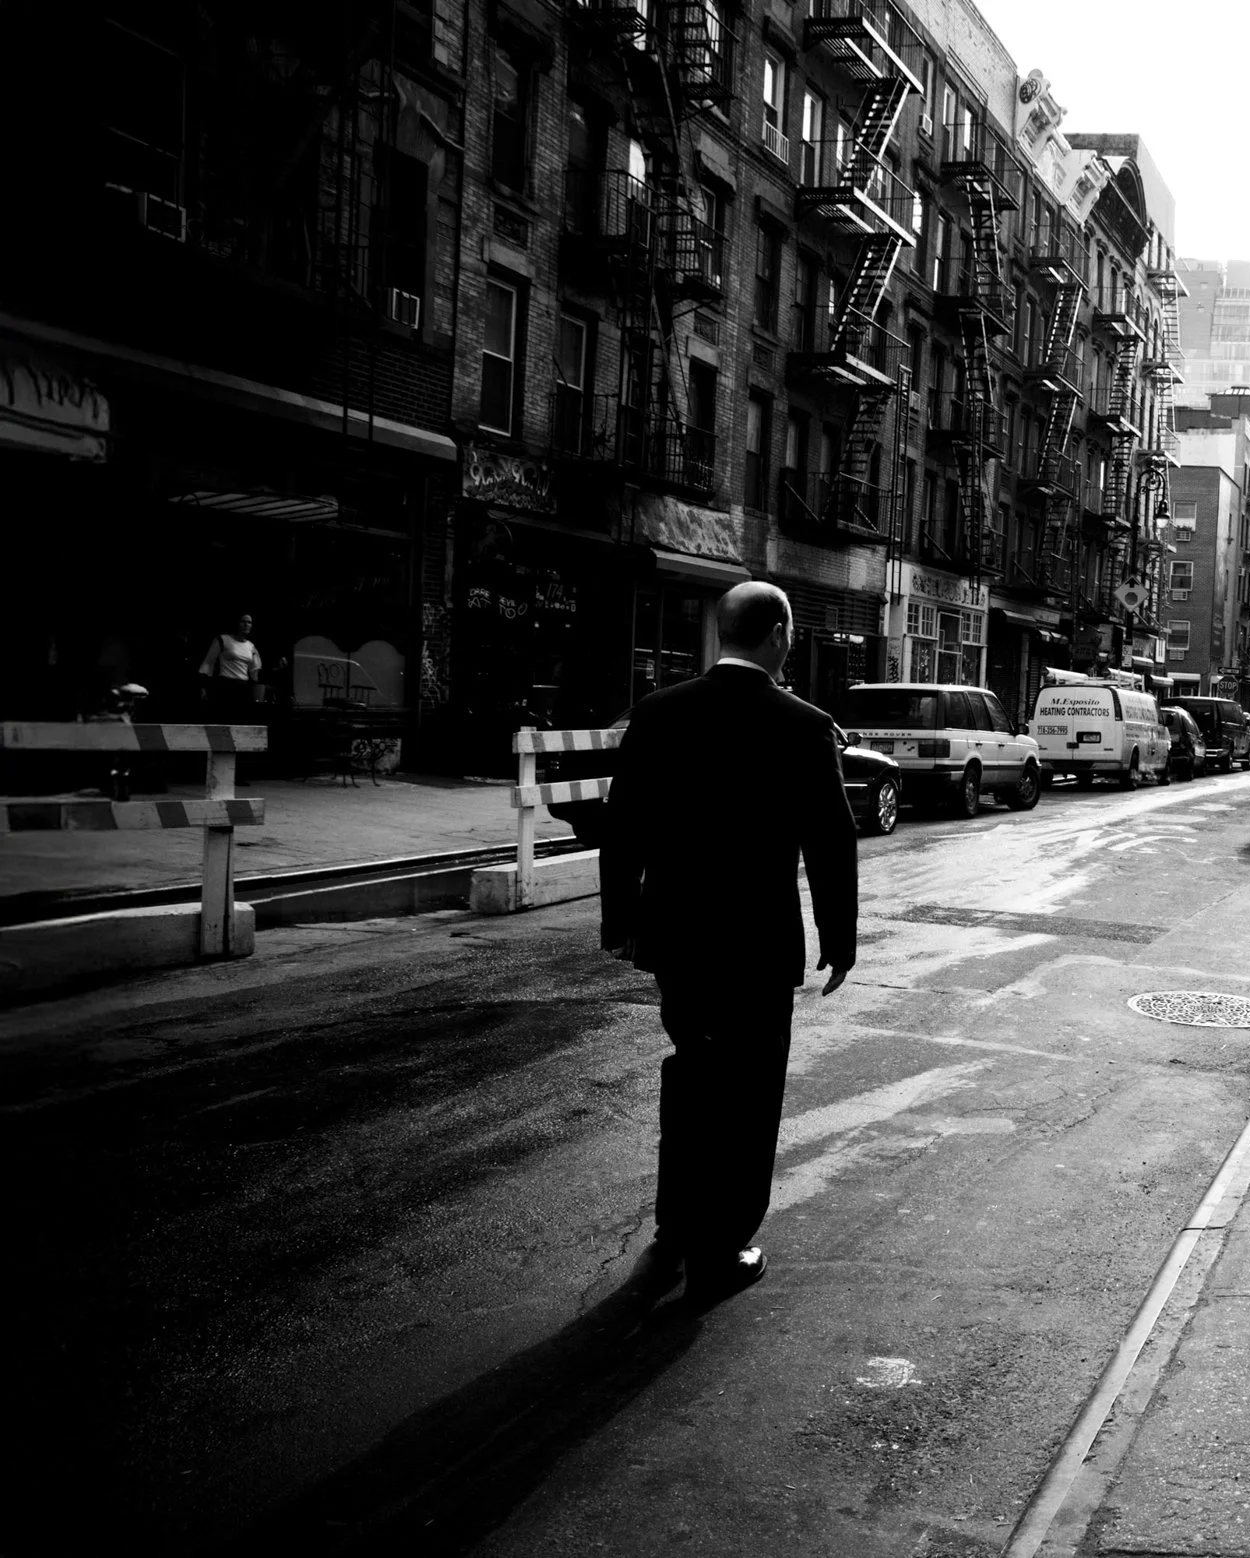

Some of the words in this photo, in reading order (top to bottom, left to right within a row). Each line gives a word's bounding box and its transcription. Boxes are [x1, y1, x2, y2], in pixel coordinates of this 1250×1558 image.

[1220, 681, 1238, 690] STOP
[1040, 707, 1066, 716] HEATING
[1067, 707, 1110, 717] CONTRACTORS
